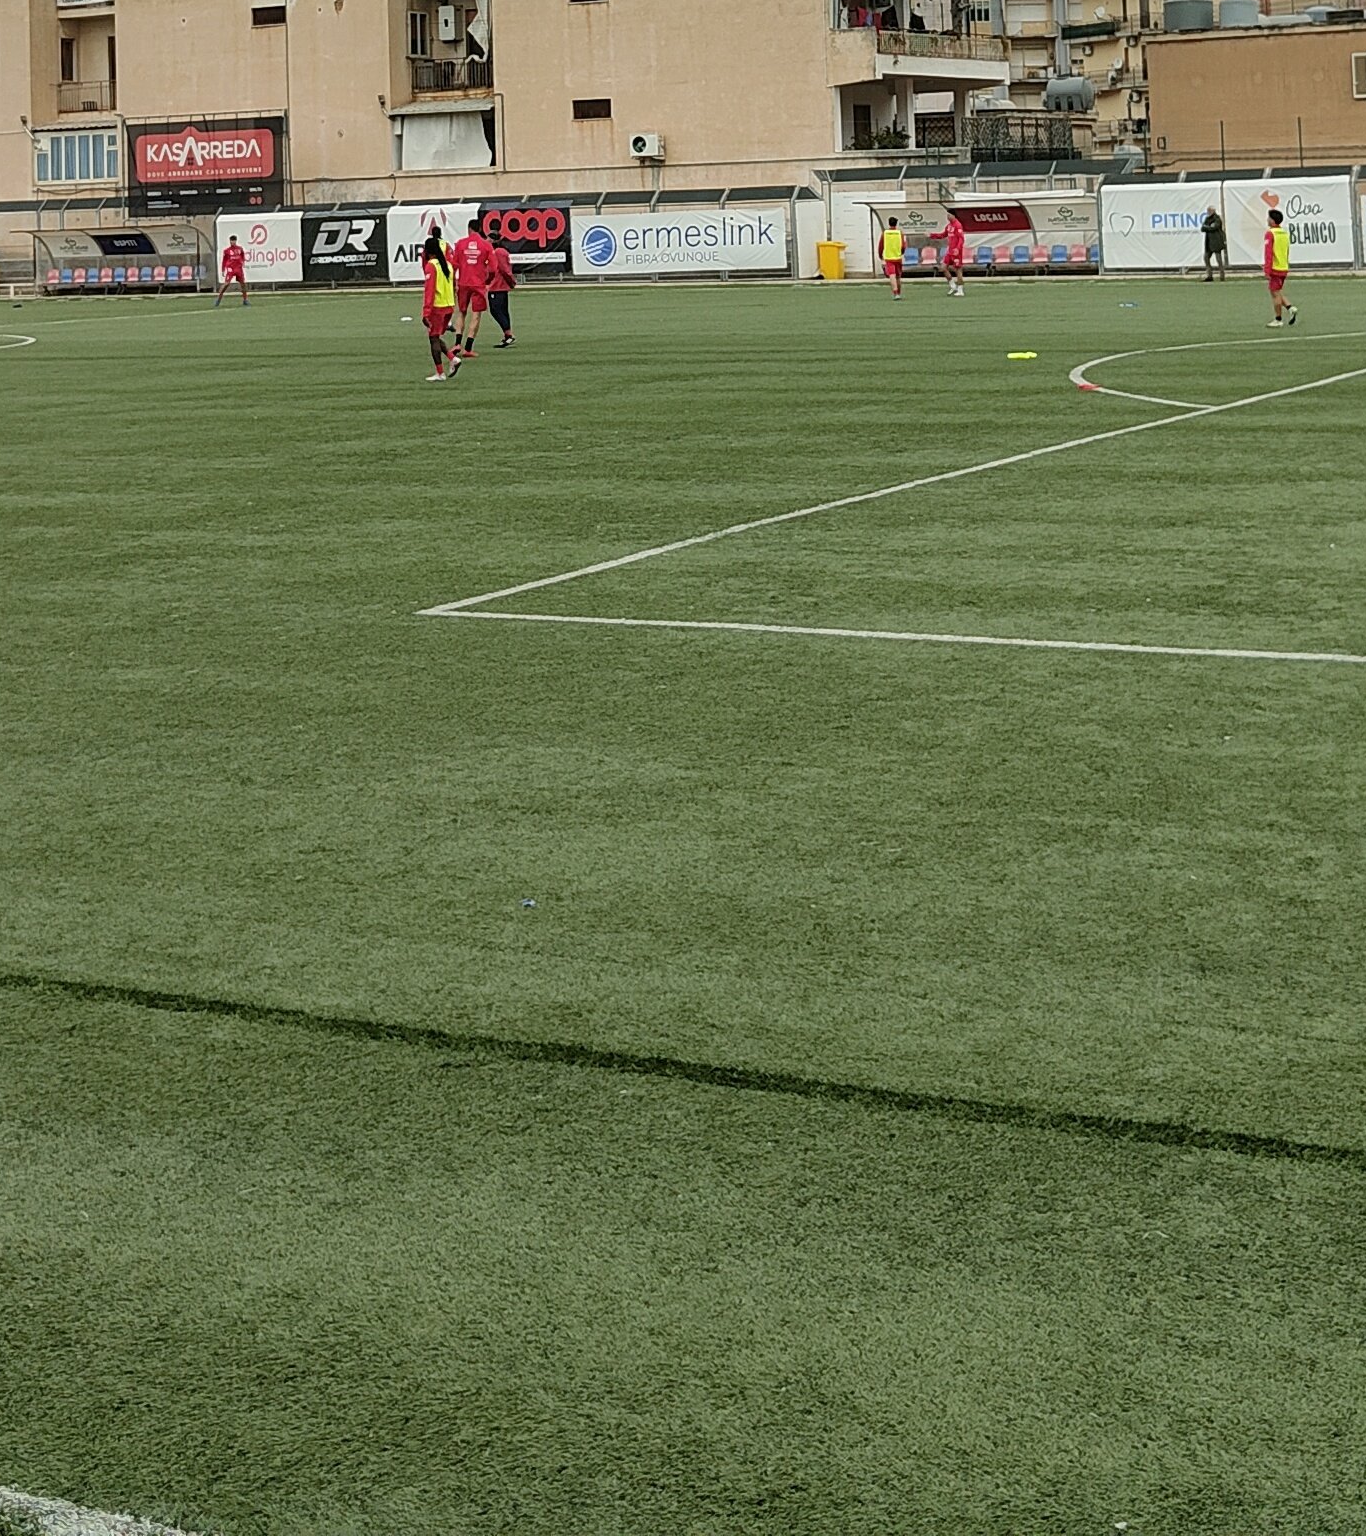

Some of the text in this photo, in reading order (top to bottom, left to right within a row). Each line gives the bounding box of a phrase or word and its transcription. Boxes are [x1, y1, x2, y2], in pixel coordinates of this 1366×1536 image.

[146, 136, 262, 167] KASARREDA
[312, 219, 376, 254] DR
[483, 208, 566, 248] coop
[623, 215, 775, 251] ermeslink
[1288, 221, 1337, 245] BLANCO
[625, 251, 720, 265] FIBRA OVUNQUE
